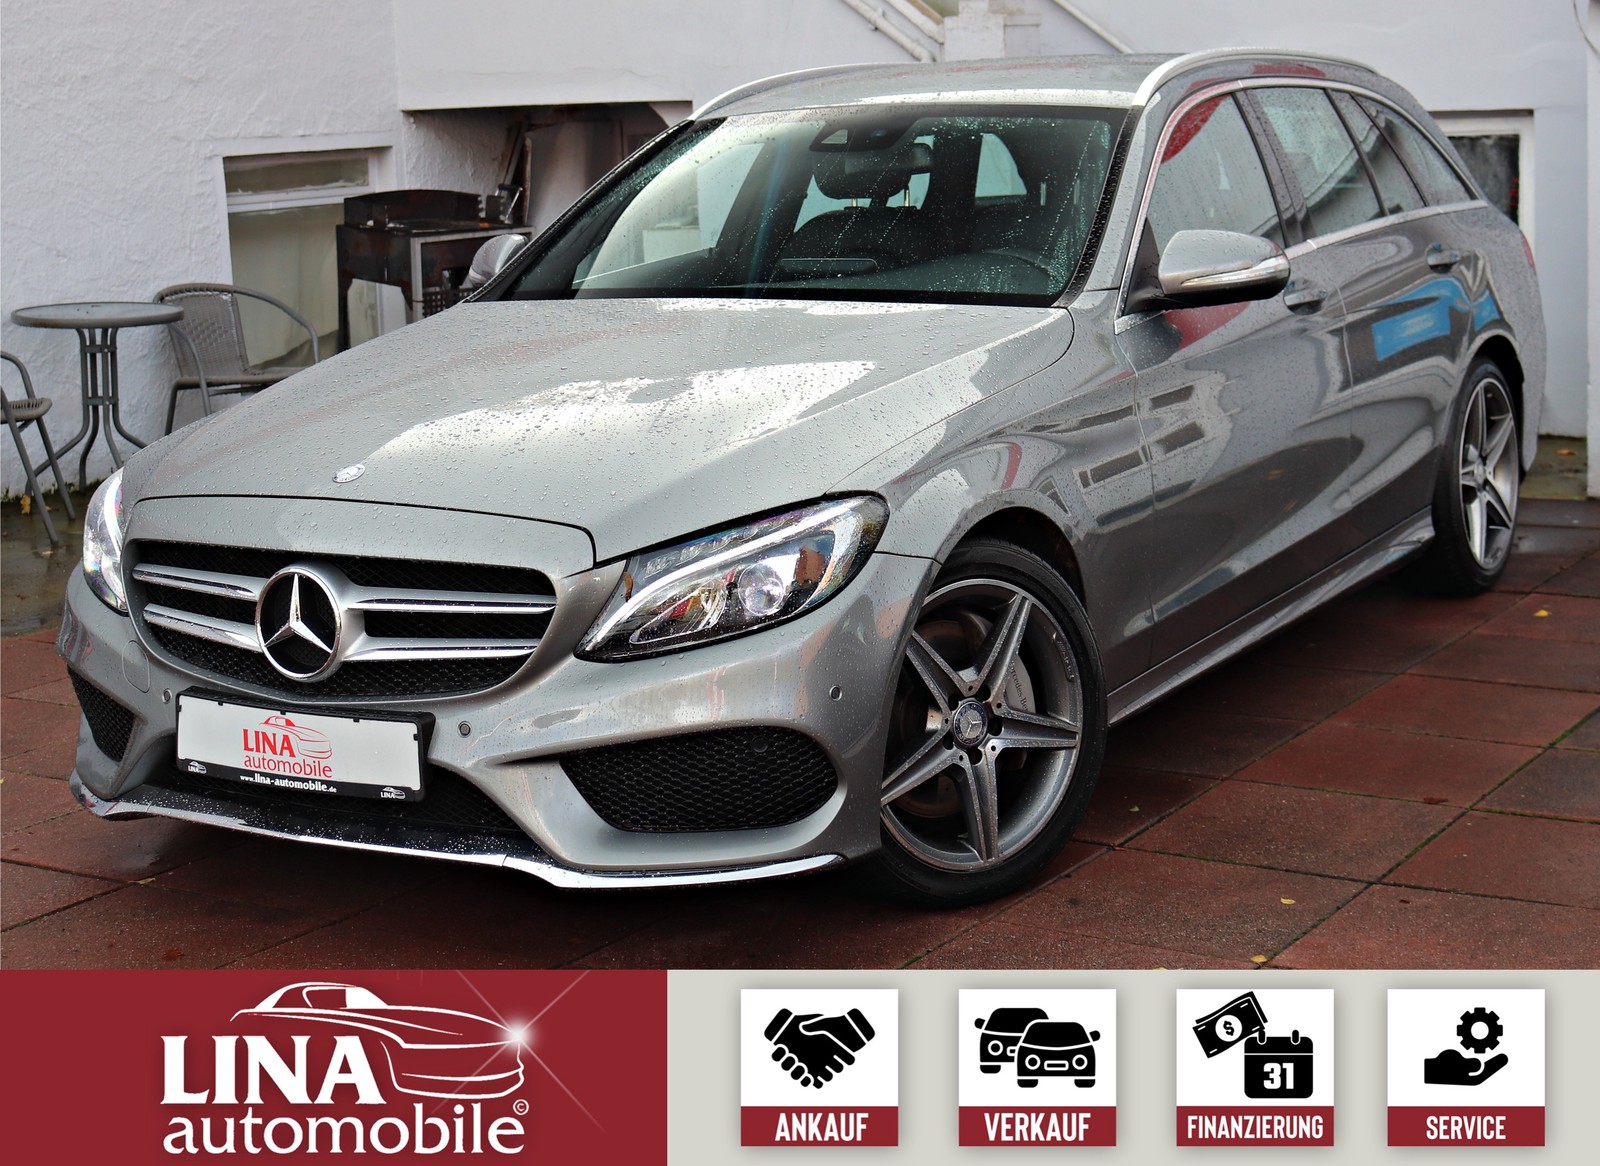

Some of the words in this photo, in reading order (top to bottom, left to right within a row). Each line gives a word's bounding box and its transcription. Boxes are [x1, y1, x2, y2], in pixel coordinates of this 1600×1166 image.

[242, 728, 297, 758] LINA
[244, 754, 333, 779] automobile
[240, 773, 338, 793] www.lina-automobile.de
[380, 790, 396, 800] LINA
